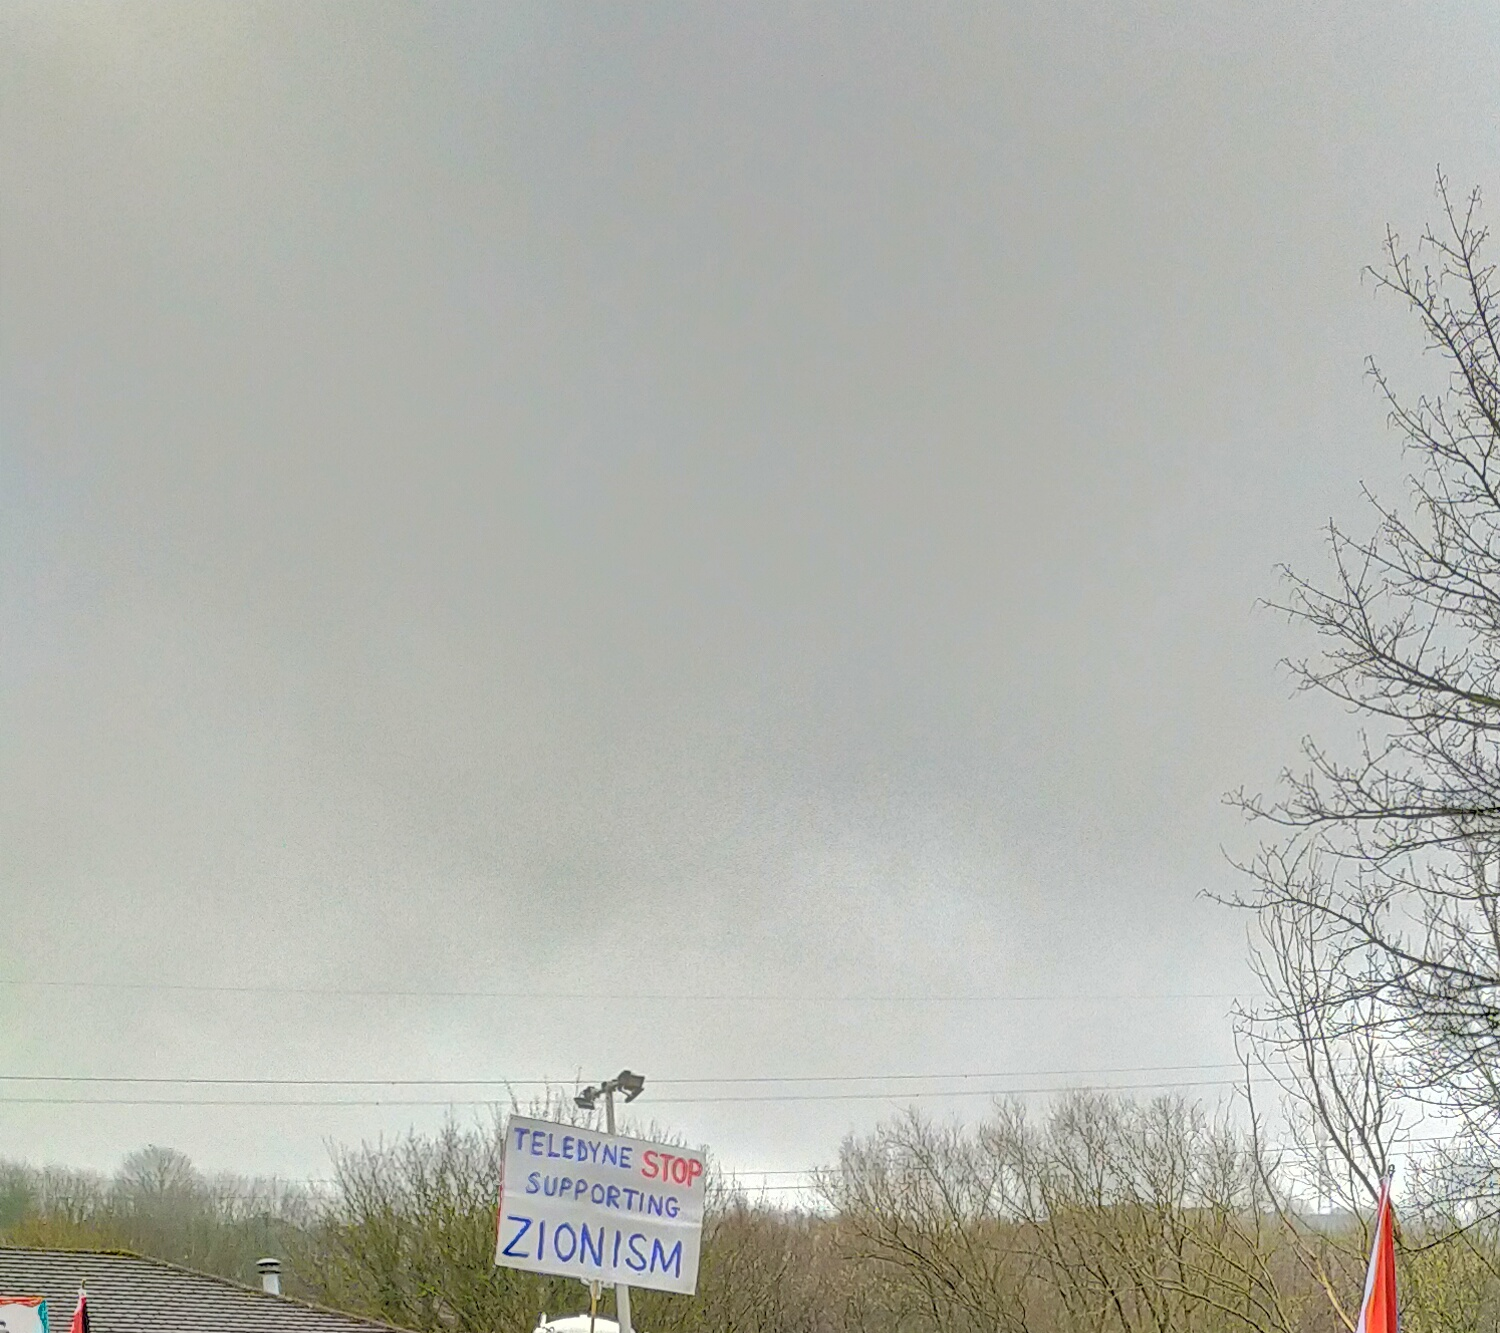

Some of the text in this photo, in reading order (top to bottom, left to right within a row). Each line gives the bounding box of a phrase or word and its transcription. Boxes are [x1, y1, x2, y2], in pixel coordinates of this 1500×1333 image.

[513, 1126, 703, 1189] TELEDYNE STOP
[525, 1171, 680, 1218] SUPPORTING
[502, 1215, 683, 1279] ZIONISM
